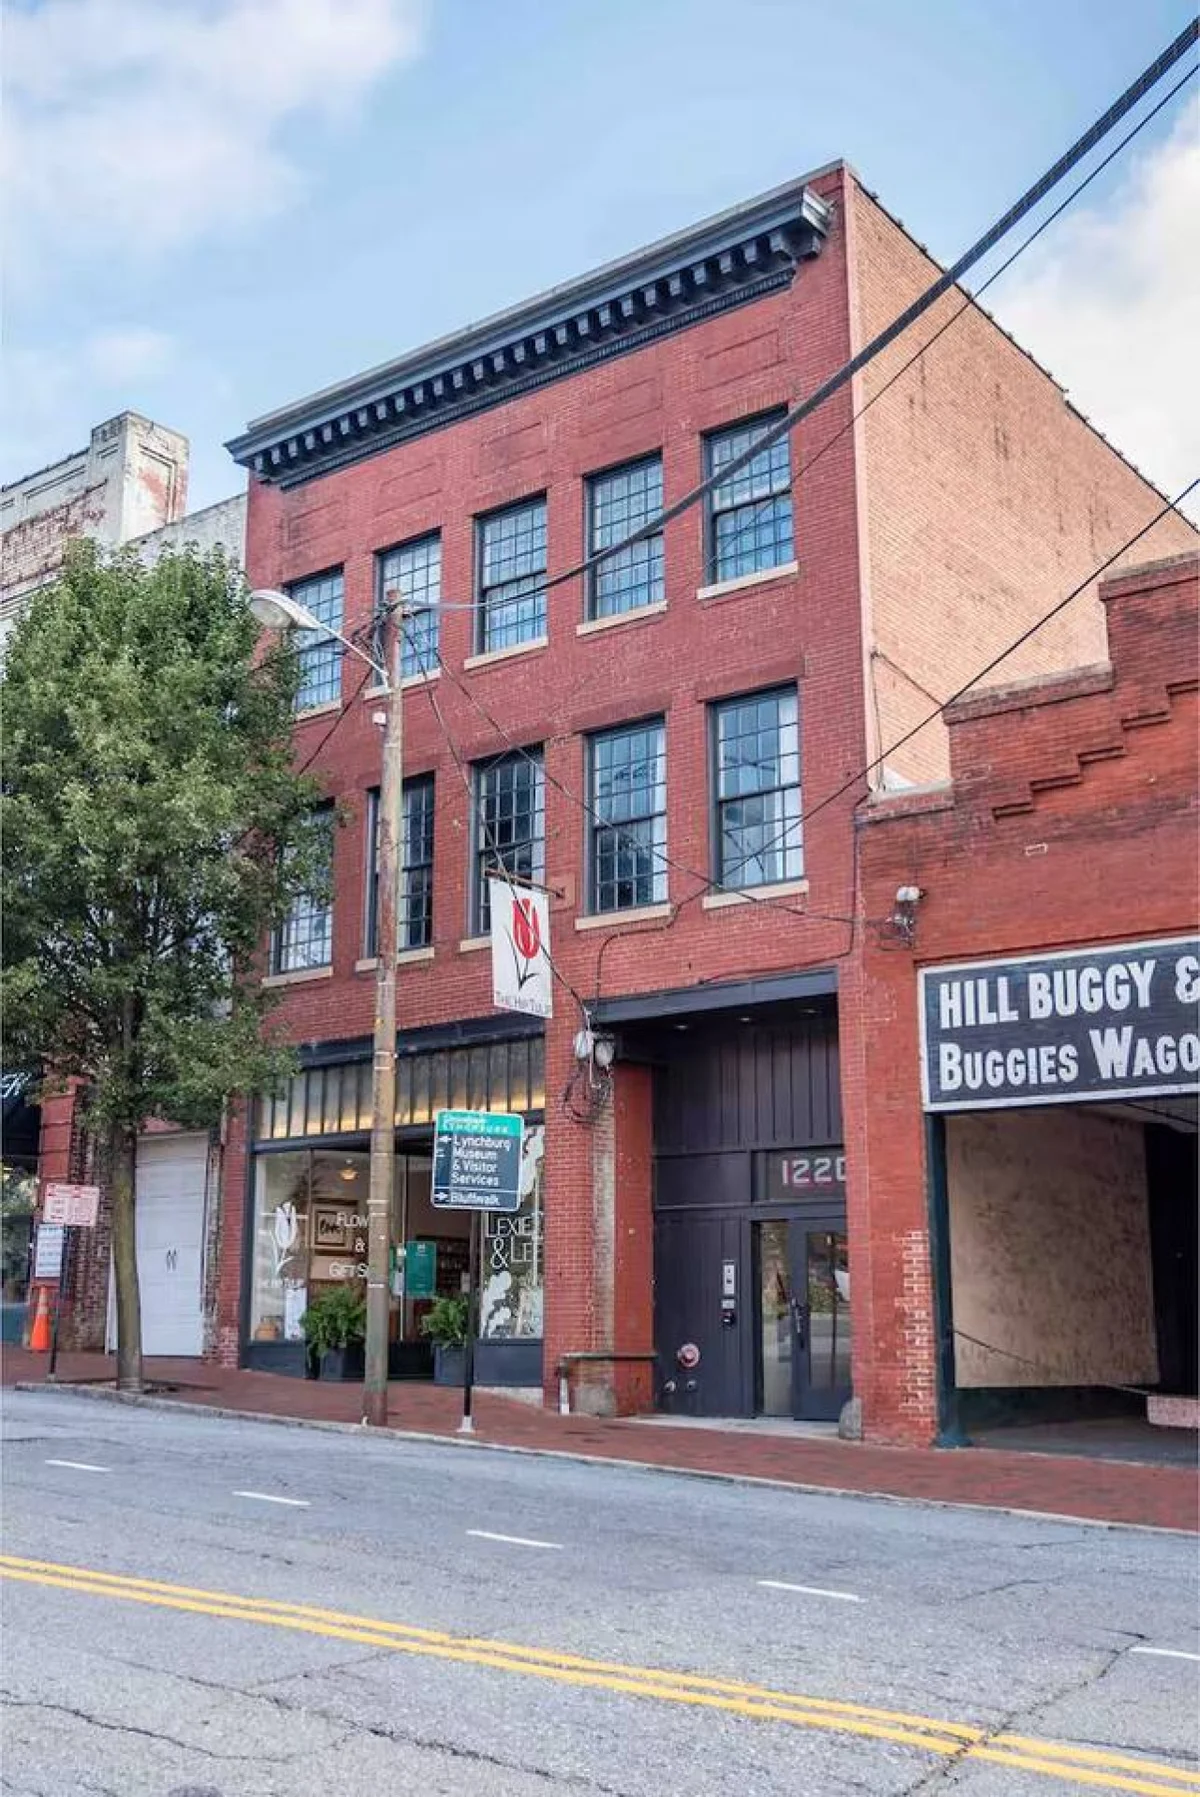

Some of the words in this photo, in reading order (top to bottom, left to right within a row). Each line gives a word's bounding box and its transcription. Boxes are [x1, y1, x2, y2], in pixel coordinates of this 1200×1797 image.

[940, 977, 1018, 1029] HILL
[1028, 960, 1155, 1020] BUGGY
[1174, 956, 1199, 1003] &
[939, 1042, 1079, 1091] BUGGIES
[453, 1135, 511, 1151] Lynchburg
[452, 1147, 498, 1160] Museum
[452, 1159, 460, 1171] &
[462, 1159, 497, 1173] Visitor
[451, 1171, 499, 1186] Services
